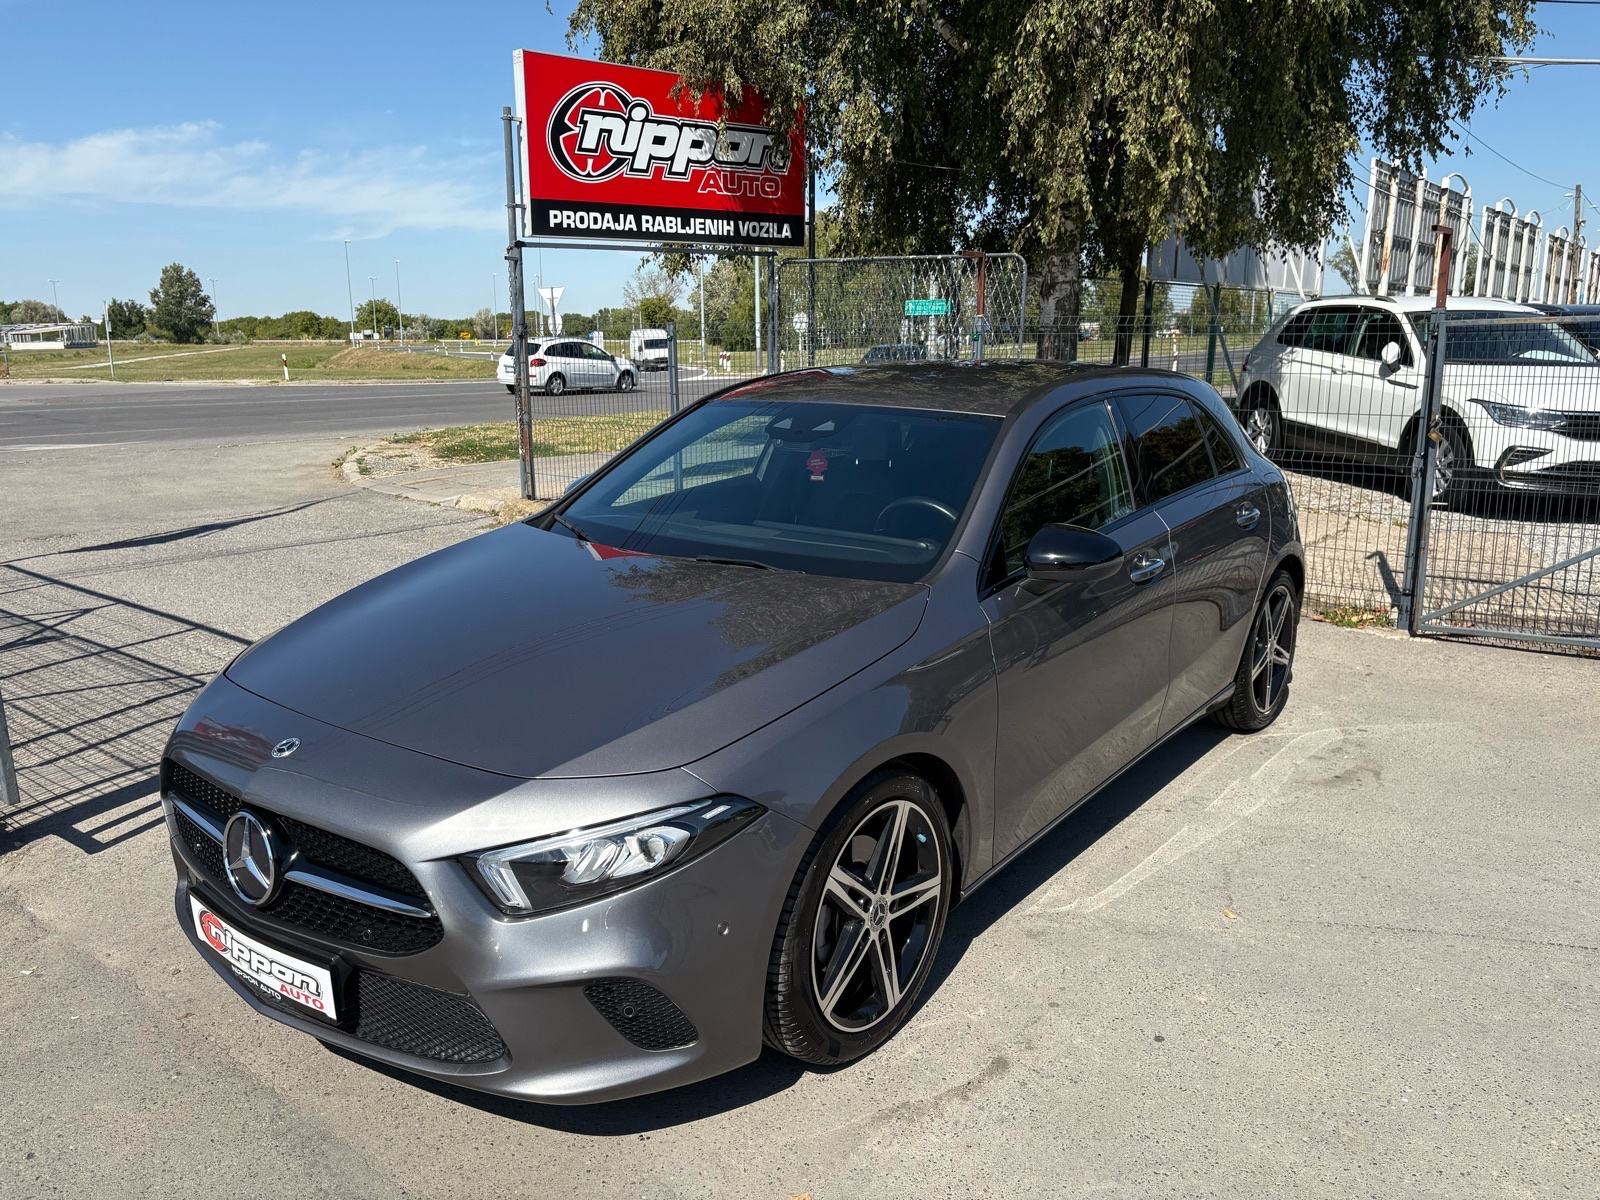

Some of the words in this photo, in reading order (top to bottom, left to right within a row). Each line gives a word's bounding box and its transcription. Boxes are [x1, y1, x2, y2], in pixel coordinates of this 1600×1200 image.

[698, 171, 781, 198] AUTO
[549, 209, 638, 232] PRODAJA
[642, 215, 734, 236] RABLJENIH
[738, 220, 792, 239] VOZILA
[206, 920, 322, 998] nippon
[280, 984, 324, 1010] AUTO
